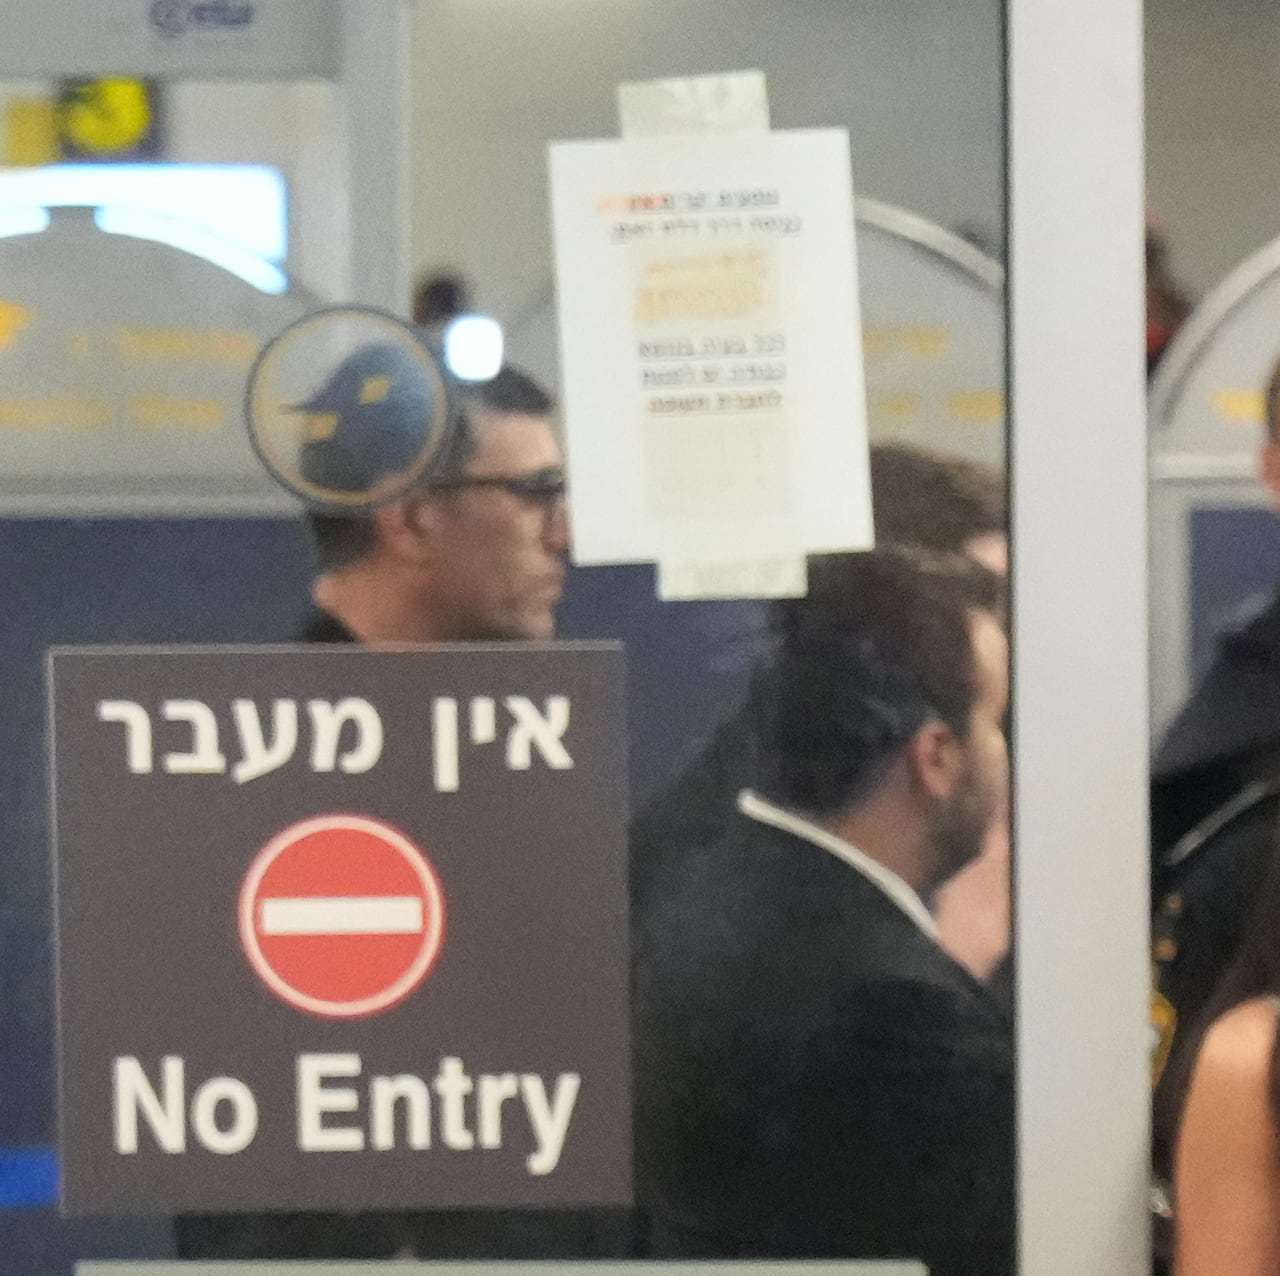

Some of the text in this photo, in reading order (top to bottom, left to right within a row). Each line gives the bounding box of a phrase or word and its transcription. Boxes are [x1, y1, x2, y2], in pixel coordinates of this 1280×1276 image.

[96, 695, 575, 793] אין מעבר
[113, 1053, 581, 1175] No Entry
